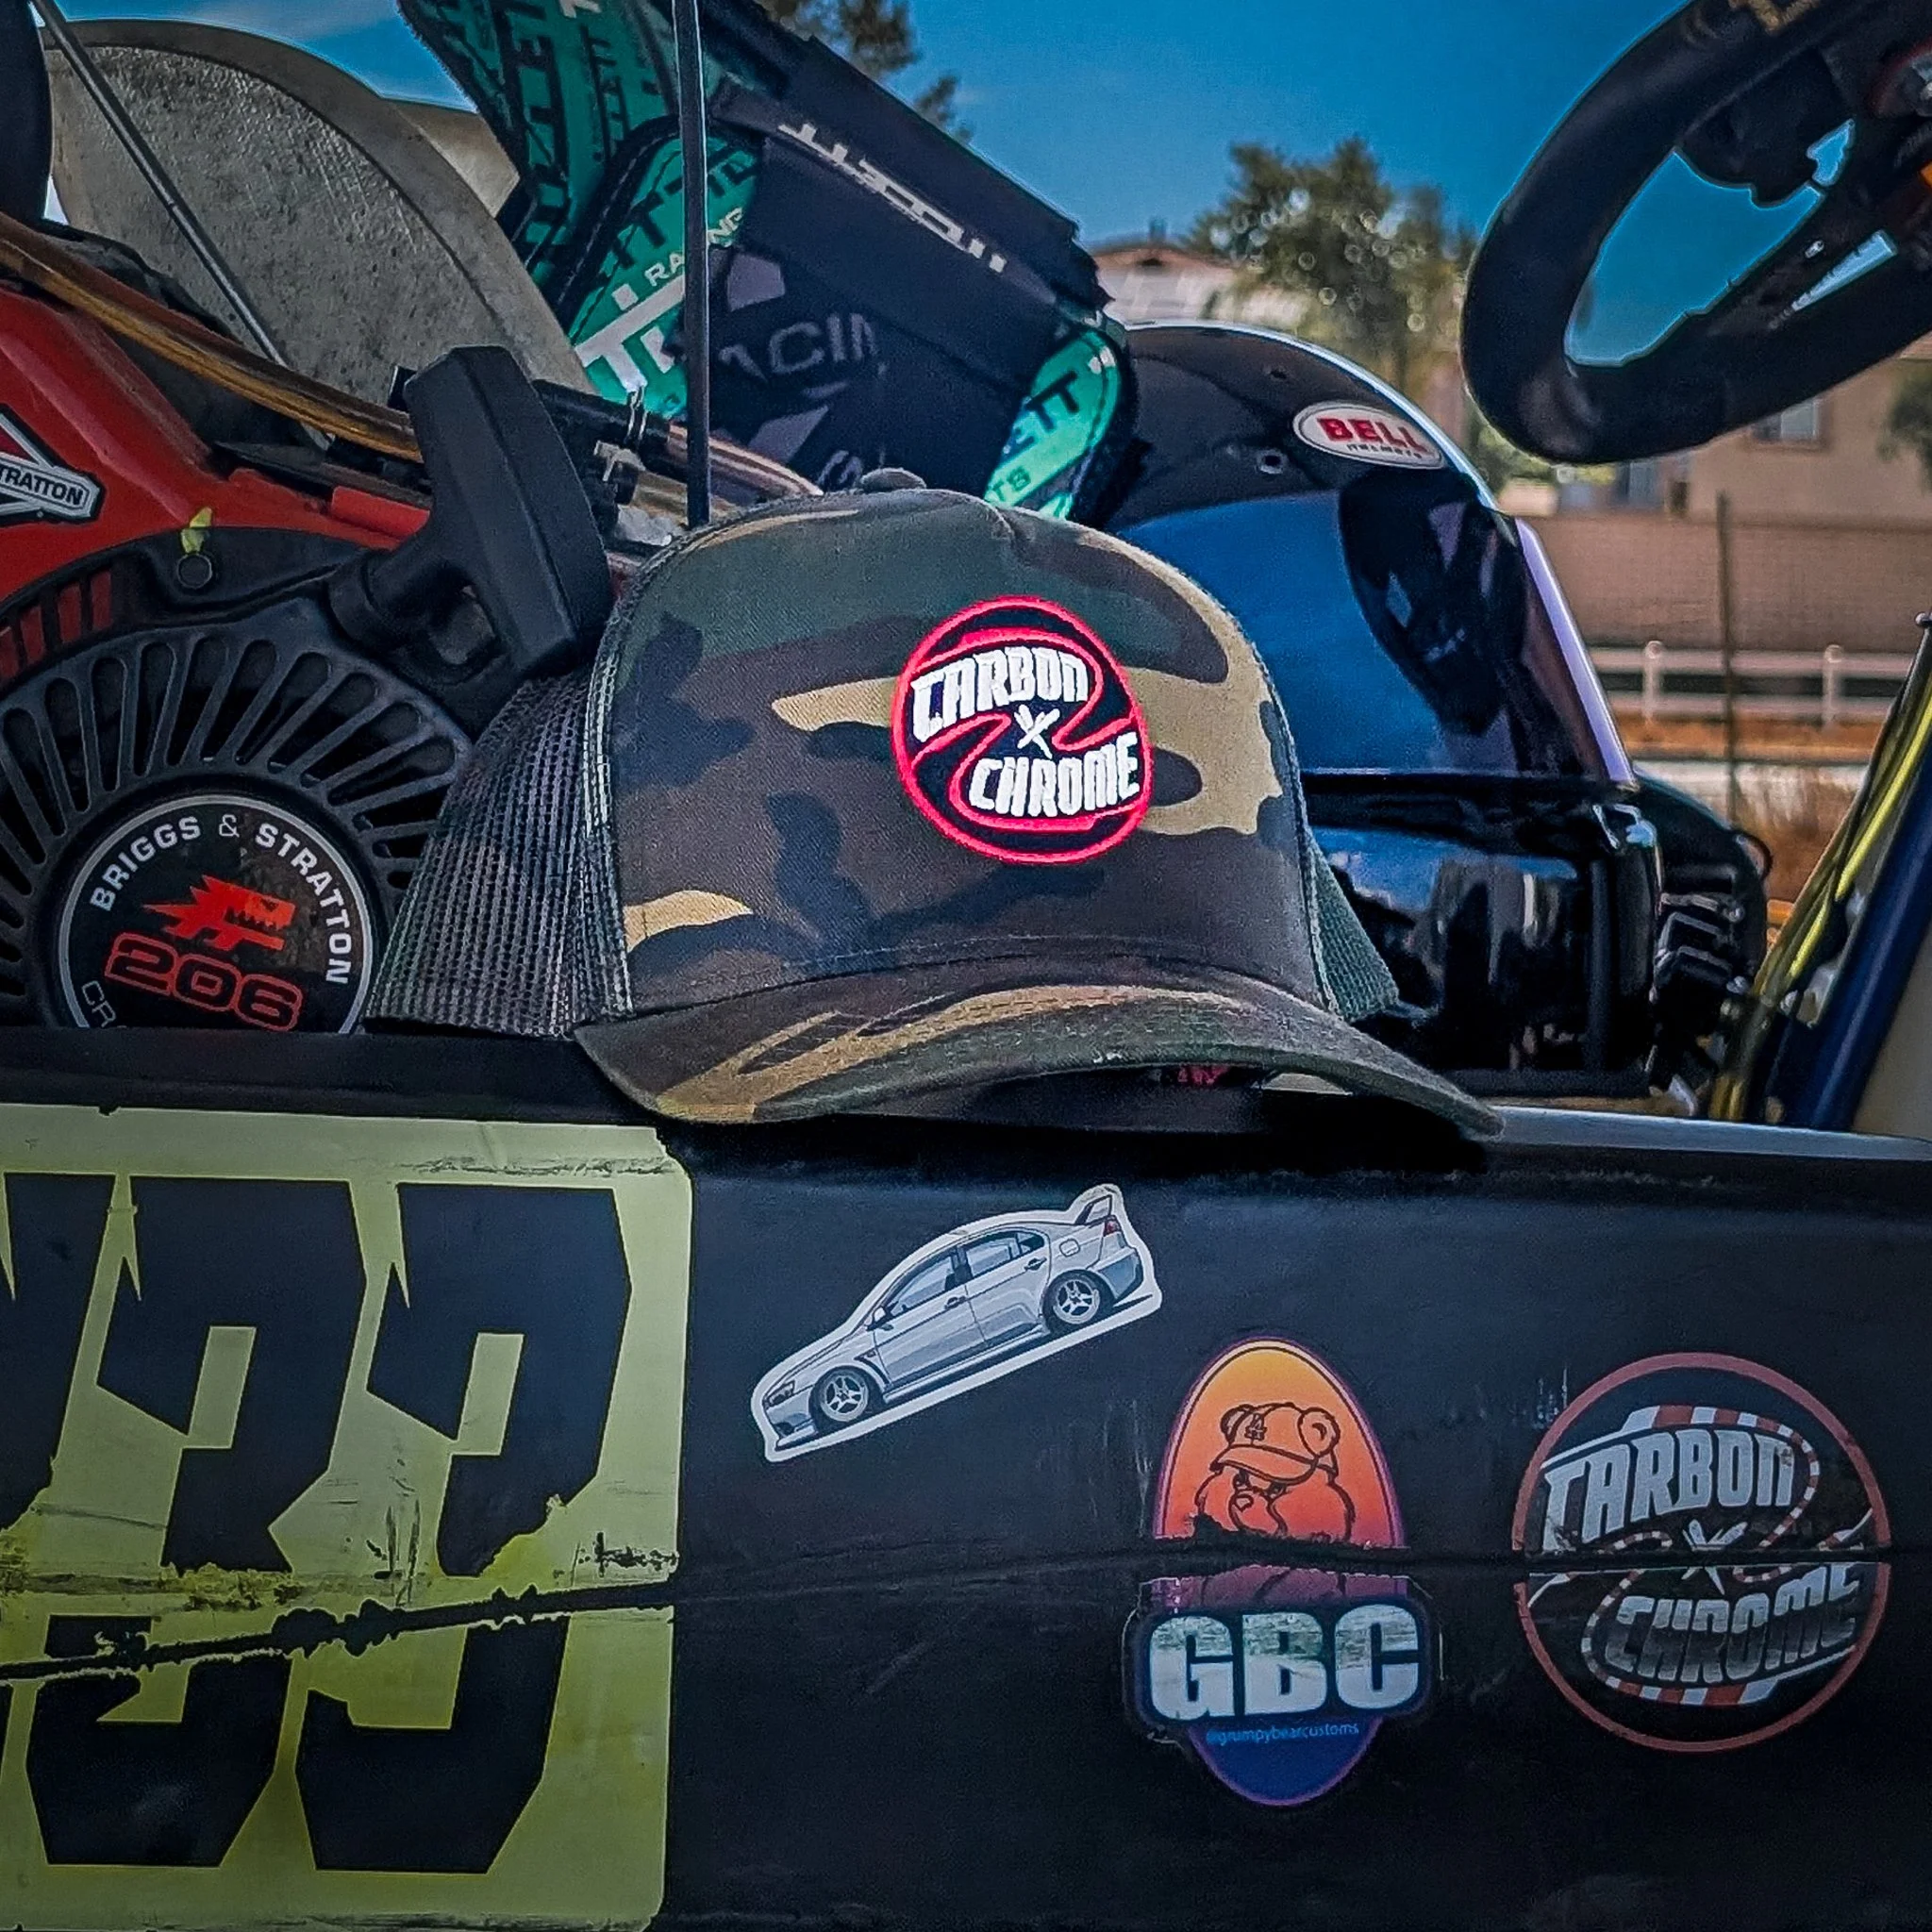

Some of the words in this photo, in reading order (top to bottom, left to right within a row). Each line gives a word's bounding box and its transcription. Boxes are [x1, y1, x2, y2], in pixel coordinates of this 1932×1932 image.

[1317, 416, 1431, 454] BELL
[910, 646, 1088, 742] CARBON
[969, 731, 1140, 817] CHROME
[90, 816, 202, 911] BRIGGS
[219, 814, 240, 838] &
[255, 823, 352, 984] STRATTON
[104, 932, 304, 1032] 206
[1149, 1604, 1420, 1721] GBC
[1605, 1562, 1860, 1683] CHROME
